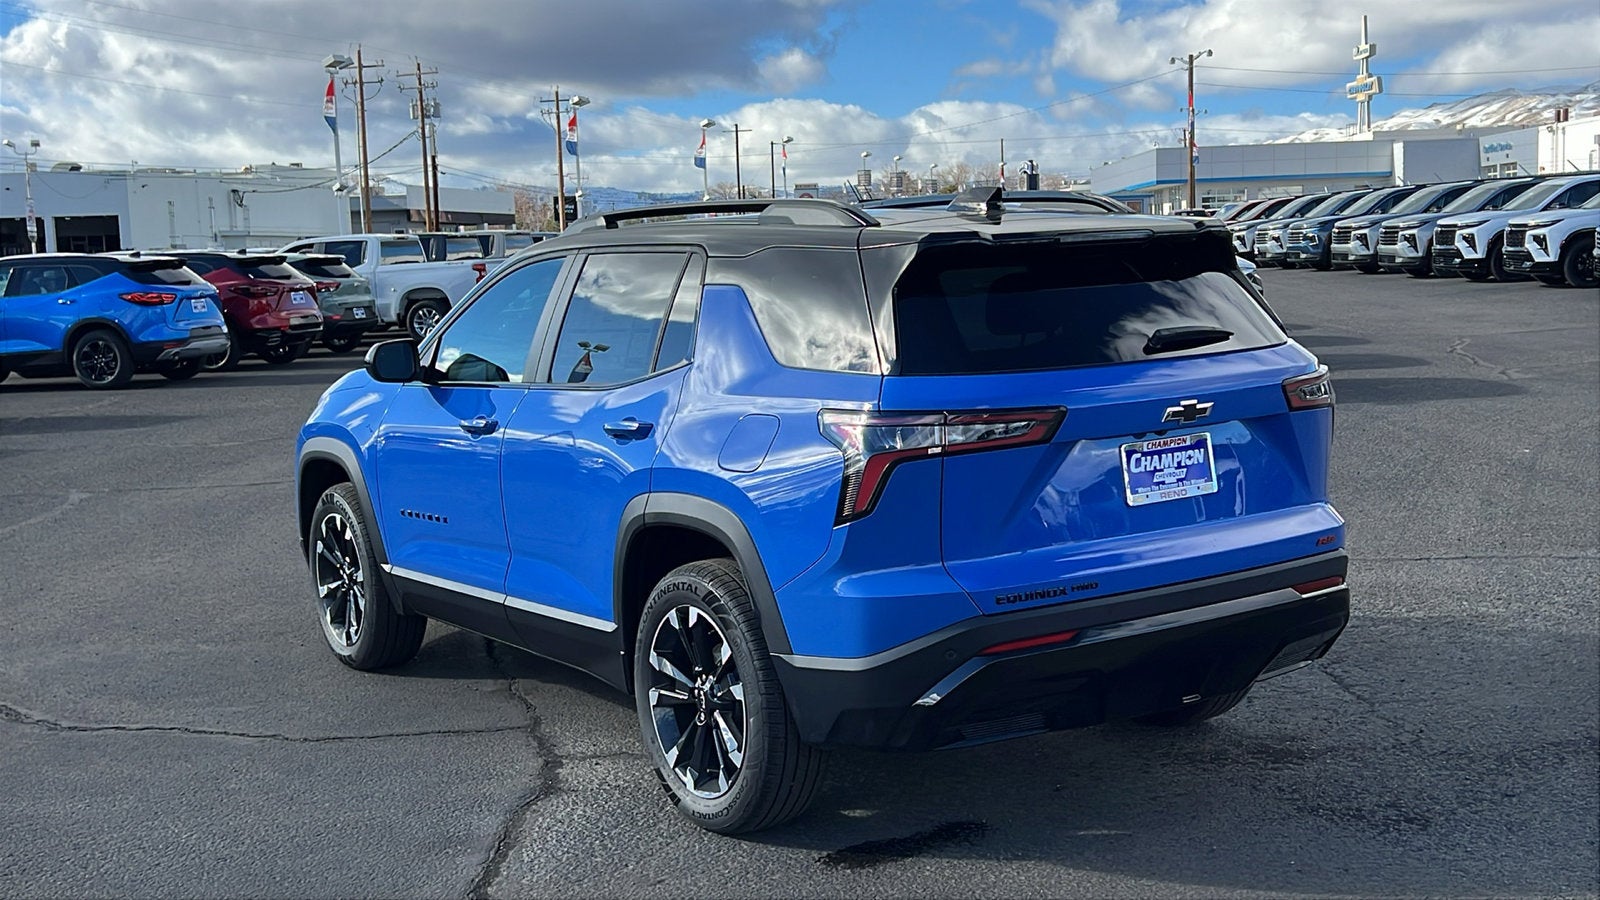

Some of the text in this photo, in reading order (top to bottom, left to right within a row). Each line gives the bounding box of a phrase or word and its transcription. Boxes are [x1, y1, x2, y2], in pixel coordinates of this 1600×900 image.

[1146, 437, 1187, 450] CHAMPION
[1130, 449, 1204, 473] CHAMPION
[1155, 470, 1186, 480] CHEVROLET
[1161, 489, 1188, 499] RENO
[995, 582, 1099, 605] EQUINOX AWD
[640, 581, 701, 634] CONTINENTAL
